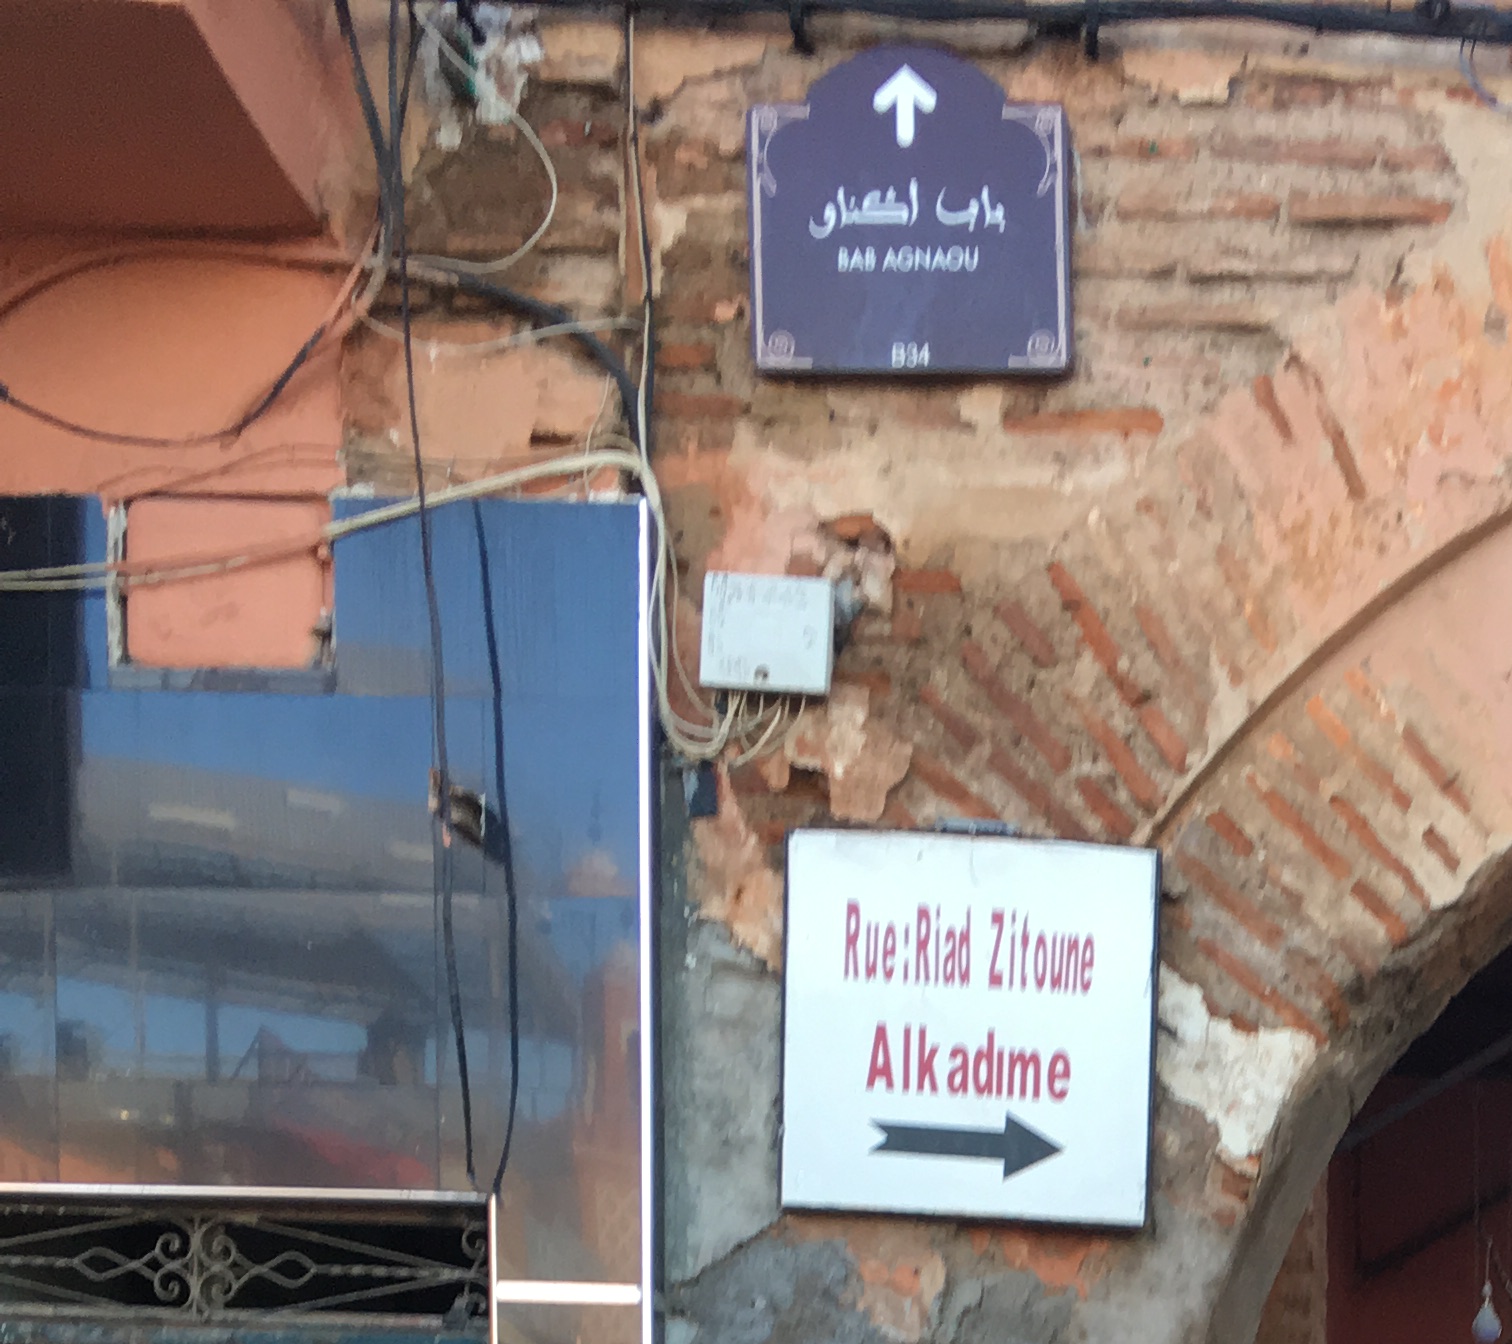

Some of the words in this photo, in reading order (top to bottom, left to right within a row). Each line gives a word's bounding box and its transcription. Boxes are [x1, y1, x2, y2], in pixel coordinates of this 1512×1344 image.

[936, 183, 1006, 234] باب
[838, 245, 876, 273] BAB
[882, 245, 979, 273] AGNAOU
[988, 906, 1095, 996] Zitoune
